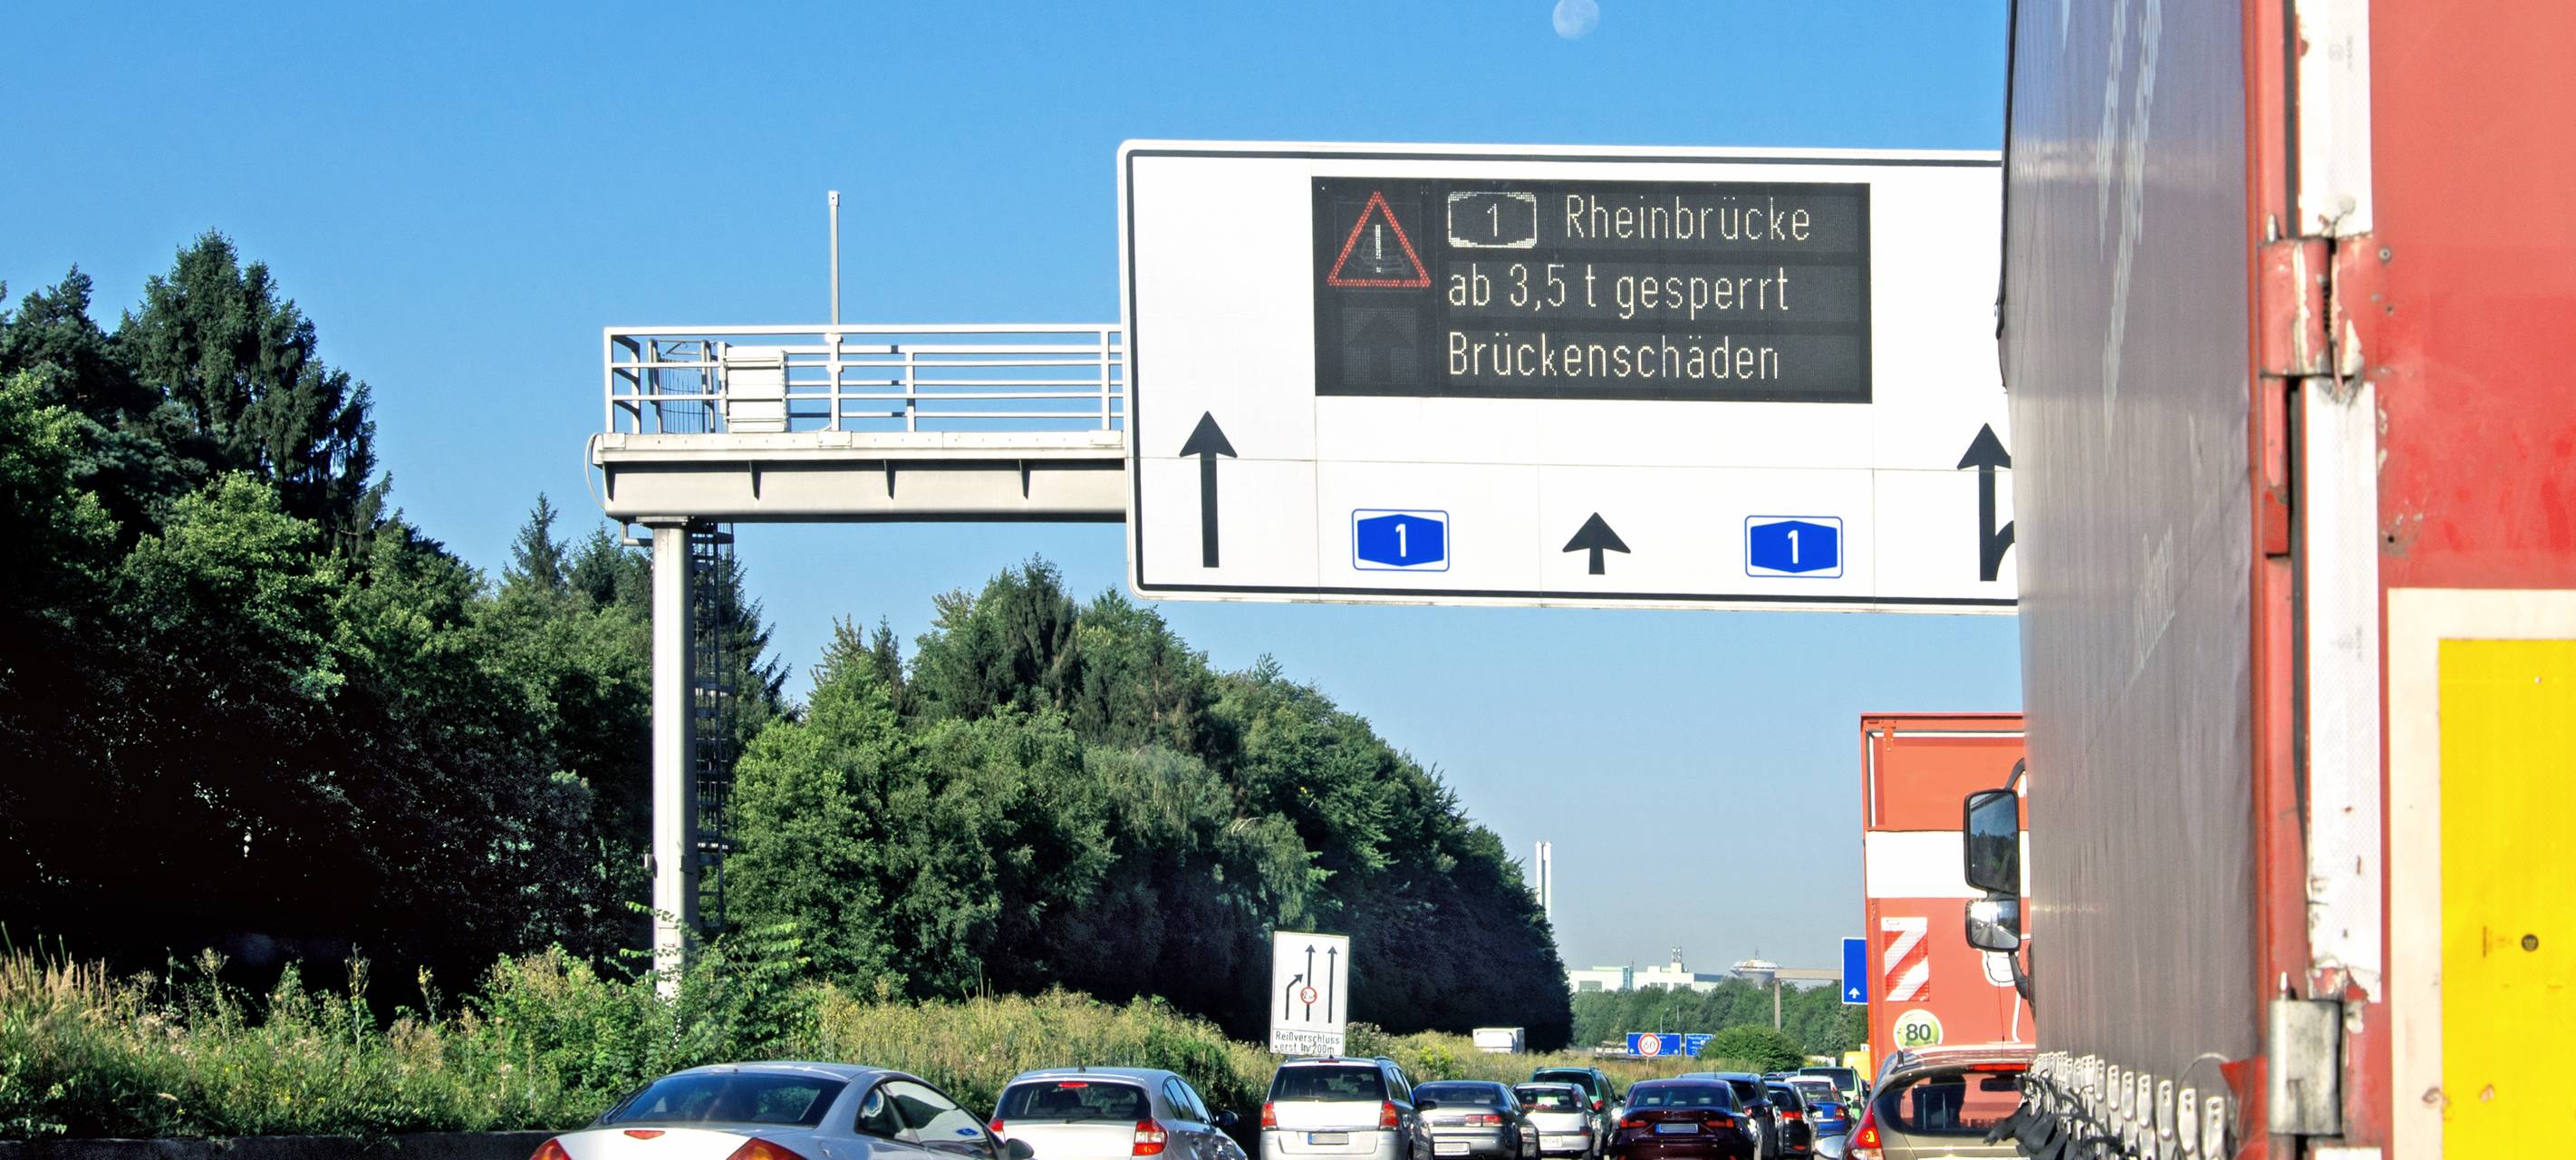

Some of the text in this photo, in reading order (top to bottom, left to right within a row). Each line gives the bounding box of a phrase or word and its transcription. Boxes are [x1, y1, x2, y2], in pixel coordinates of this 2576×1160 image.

[1486, 194, 1810, 241] 1 Rheinbrücke
[1449, 263, 1789, 321] ab 3,5 t gesperrt
[1449, 331, 1779, 380] Brückenschäden
[1394, 523, 1406, 557] 1
[1787, 529, 1799, 564] 1
[1276, 1030, 1340, 1045] Reißverschluss
[1279, 1043, 1297, 1052] erst
[1643, 1040, 1656, 1050] 60
[1905, 1023, 1932, 1041] 80
